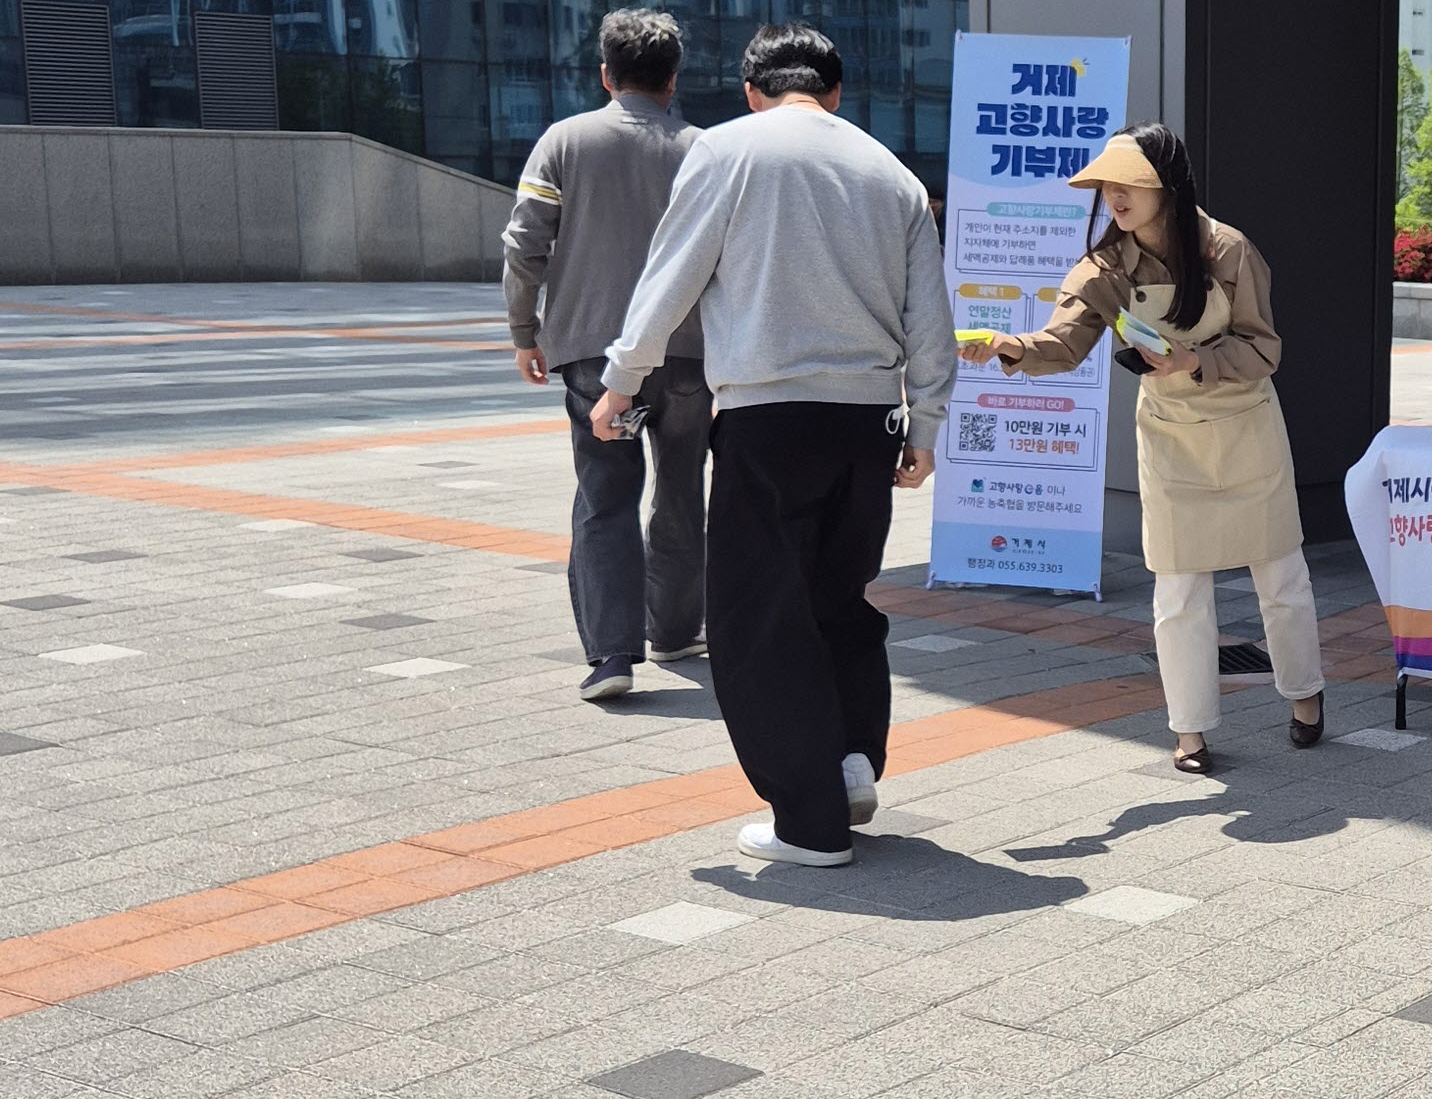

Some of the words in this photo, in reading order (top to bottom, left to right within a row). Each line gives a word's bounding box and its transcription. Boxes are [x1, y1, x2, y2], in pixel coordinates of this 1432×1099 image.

[1011, 63, 1077, 97] 거제
[976, 103, 1109, 139] 고향사랑
[991, 144, 1090, 178] 기부제
[964, 222, 991, 234] 개인이
[993, 223, 1011, 234] 현재
[1013, 224, 1048, 236] 주소지를
[1050, 226, 1077, 237] 제외한
[1001, 239, 1037, 250] 기부하면
[968, 305, 1012, 320] 연말정산
[987, 396, 1007, 407] 바로
[1009, 397, 1045, 409] 기부하러
[1047, 399, 1064, 410] GO!
[1004, 420, 1044, 435] 10만원
[1047, 422, 1071, 437] 기부
[1074, 423, 1087, 438] 시
[1008, 438, 1048, 453] 13만원
[1051, 440, 1080, 455] 혜택!
[1047, 485, 1066, 496] 이나
[957, 496, 985, 509] 가까운
[1027, 500, 1083, 514] 방문해주세요
[967, 557, 995, 570] 행정과
[997, 561, 1063, 574] 055.639.3303
